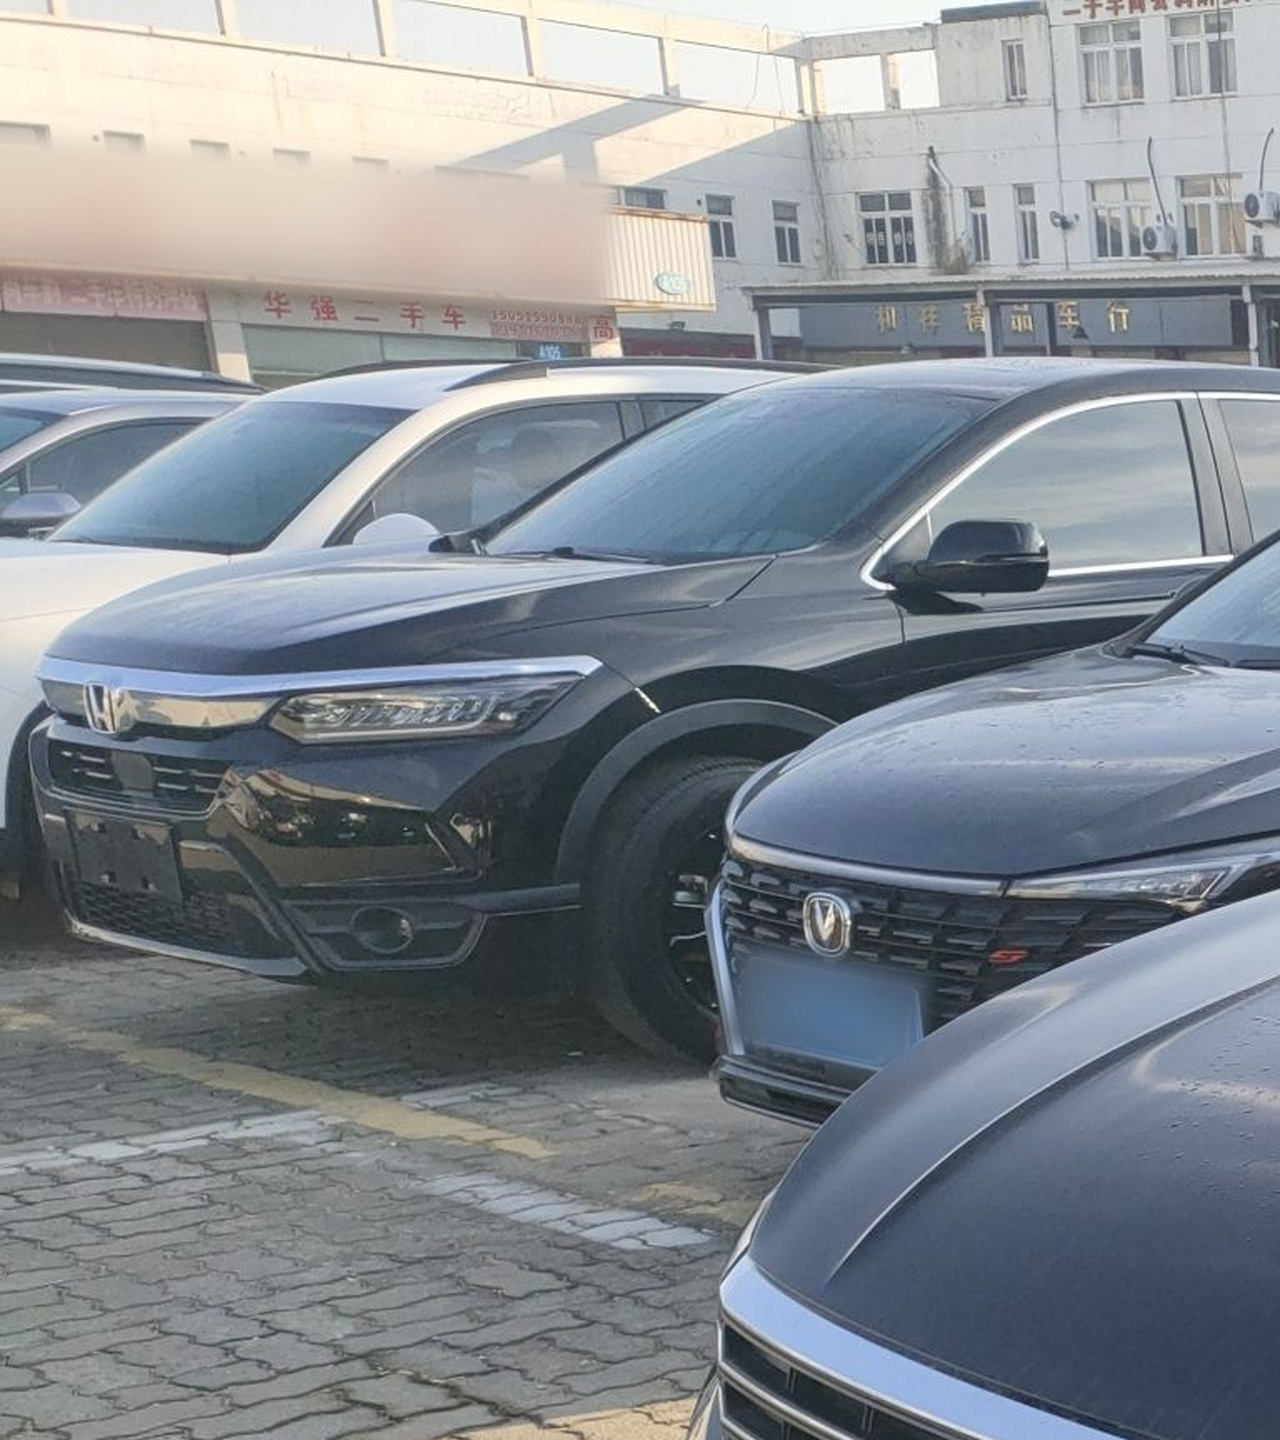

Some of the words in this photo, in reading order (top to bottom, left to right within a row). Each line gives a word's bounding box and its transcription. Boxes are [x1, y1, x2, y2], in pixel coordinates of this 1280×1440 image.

[264, 290, 466, 331] 华强二手车
